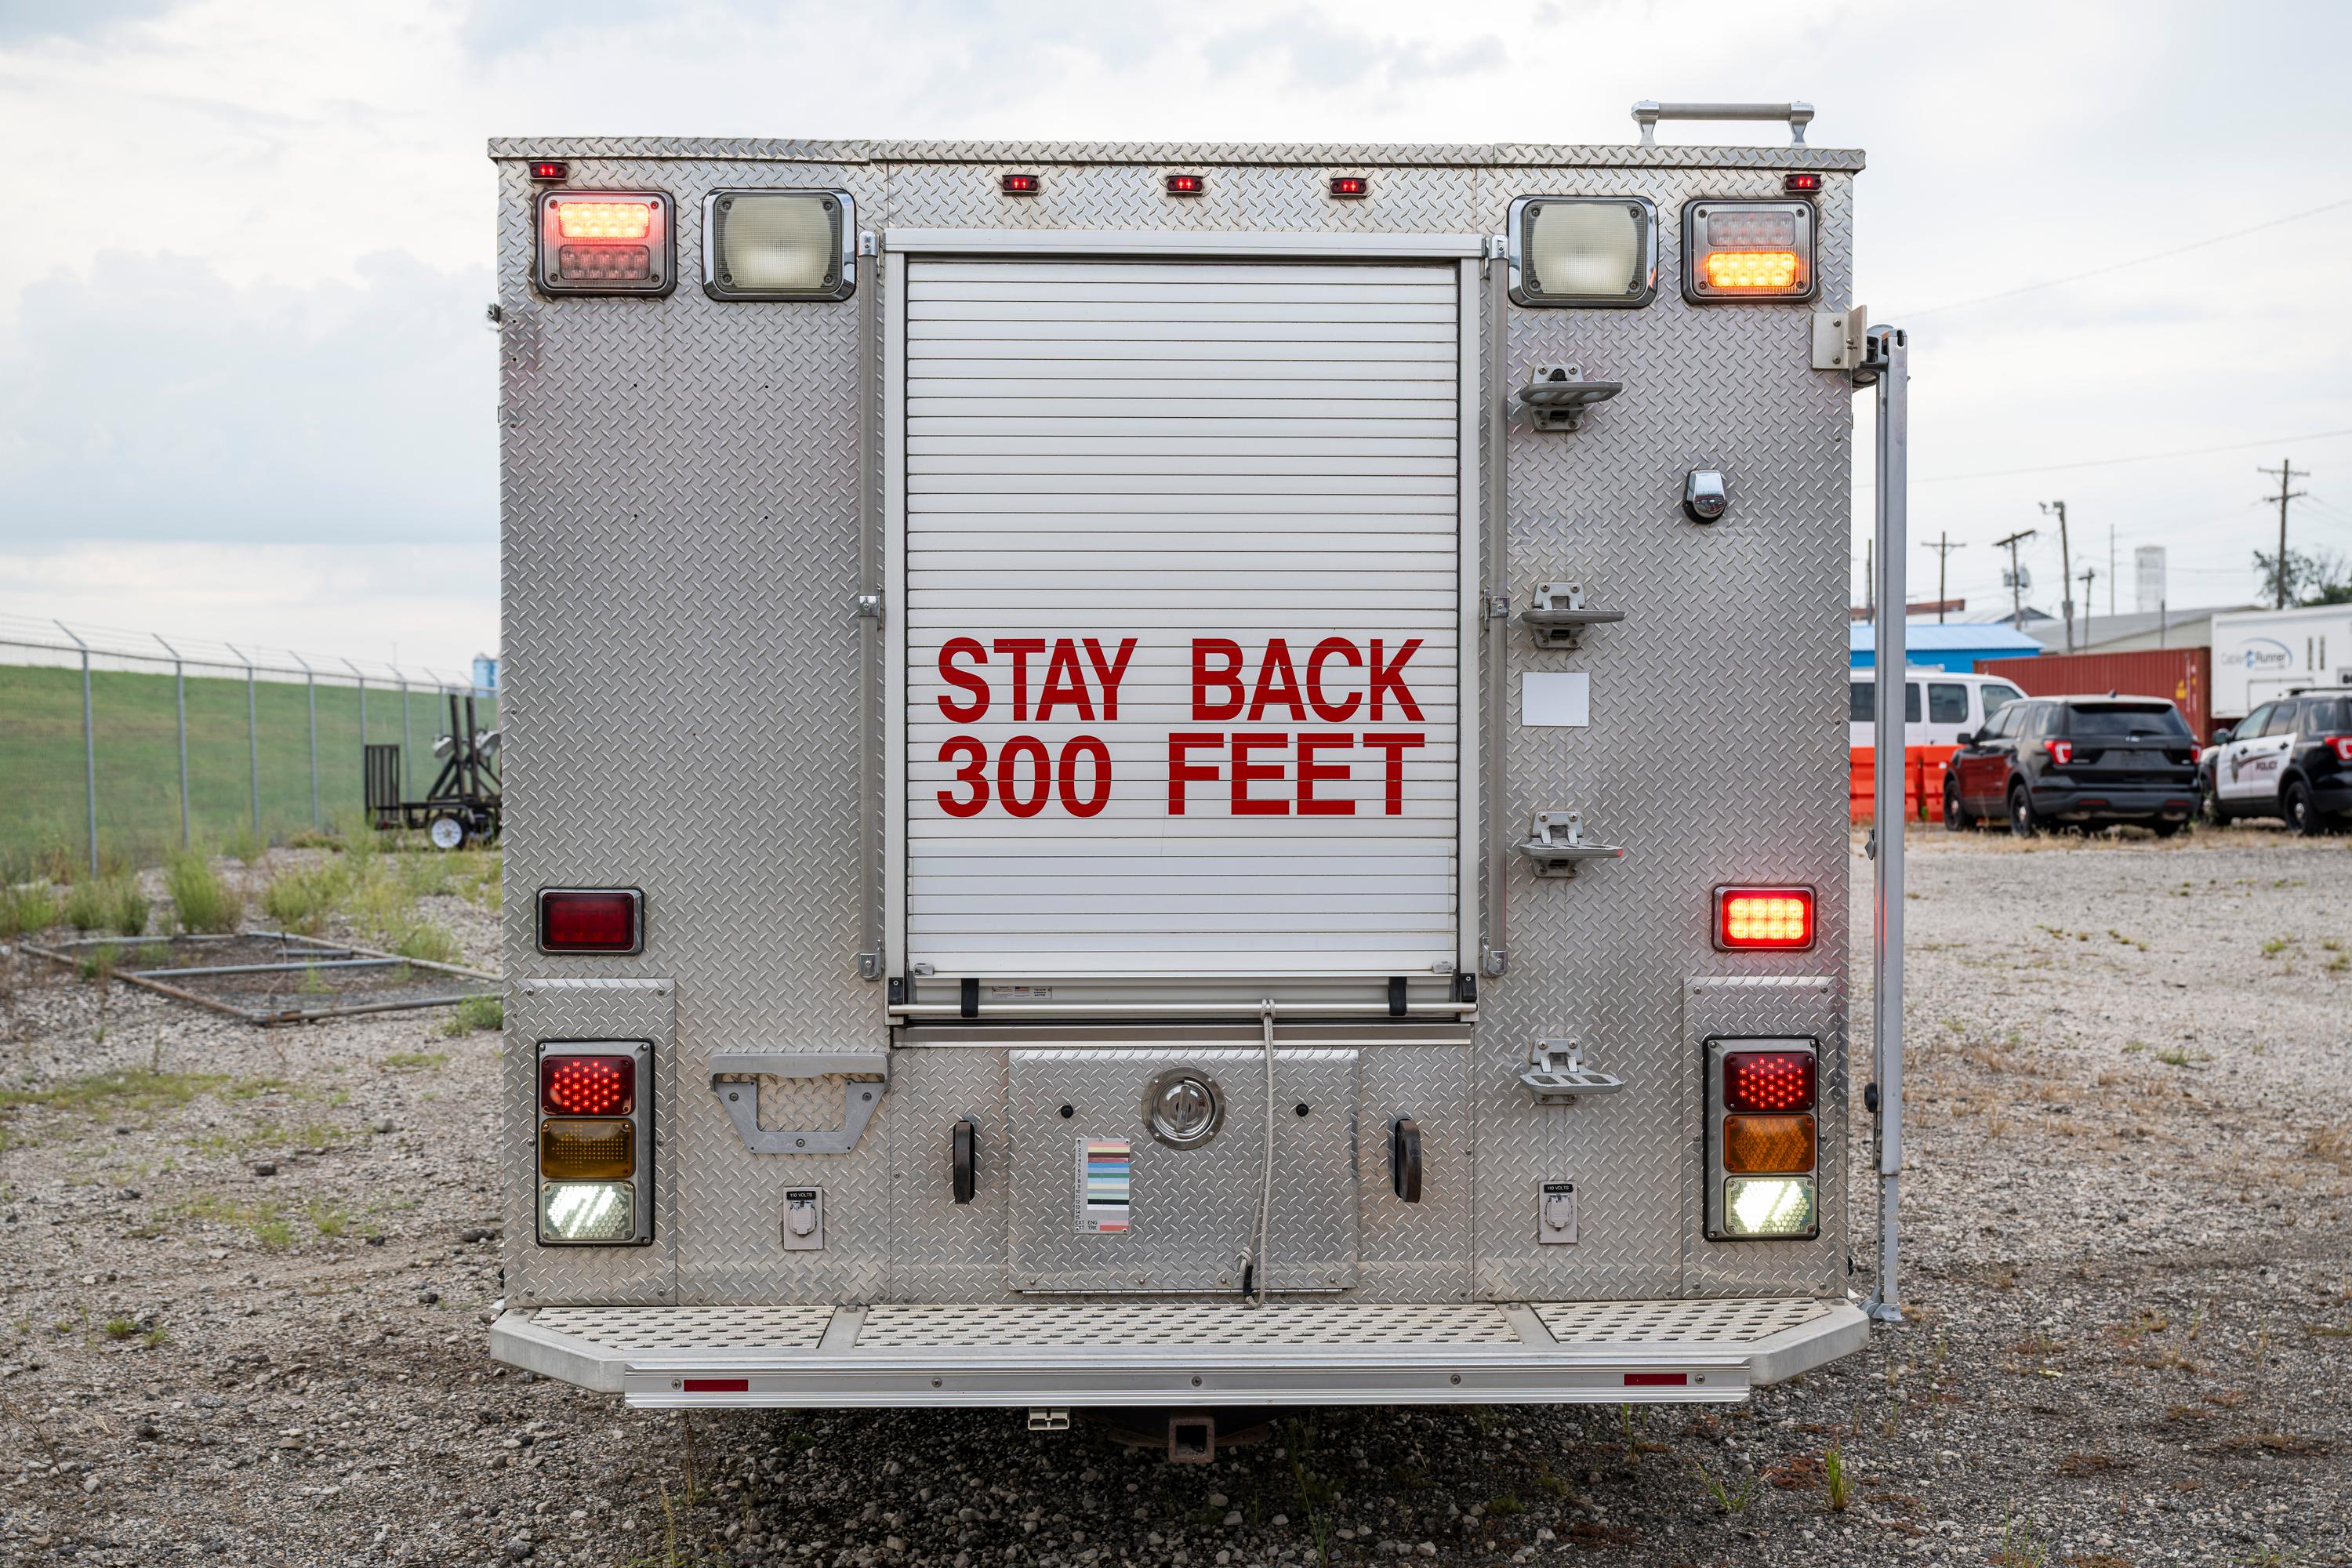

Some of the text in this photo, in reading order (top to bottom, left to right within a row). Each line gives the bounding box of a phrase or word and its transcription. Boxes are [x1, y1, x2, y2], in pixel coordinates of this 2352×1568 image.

[936, 637, 1425, 723] STAY BACK
[936, 732, 1425, 818] 300 FEET
